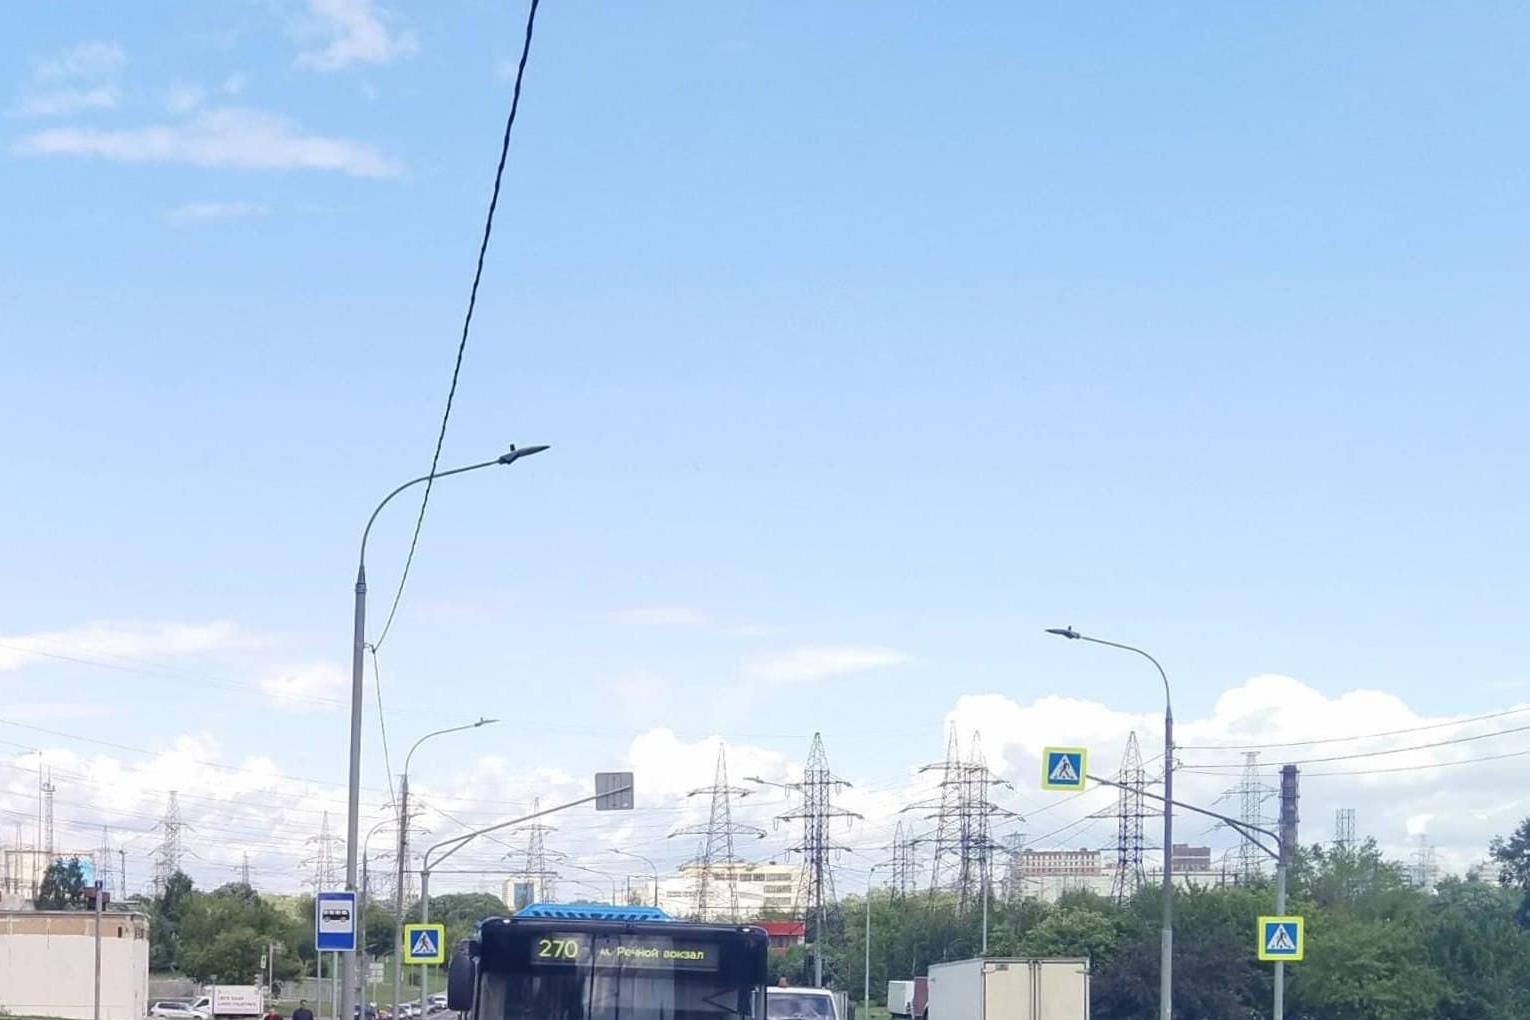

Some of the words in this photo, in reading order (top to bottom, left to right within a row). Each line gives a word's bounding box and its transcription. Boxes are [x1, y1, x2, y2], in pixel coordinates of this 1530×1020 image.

[539, 938, 579, 959] 270
[617, 946, 659, 960] Речной
[663, 950, 704, 961] вокзал
